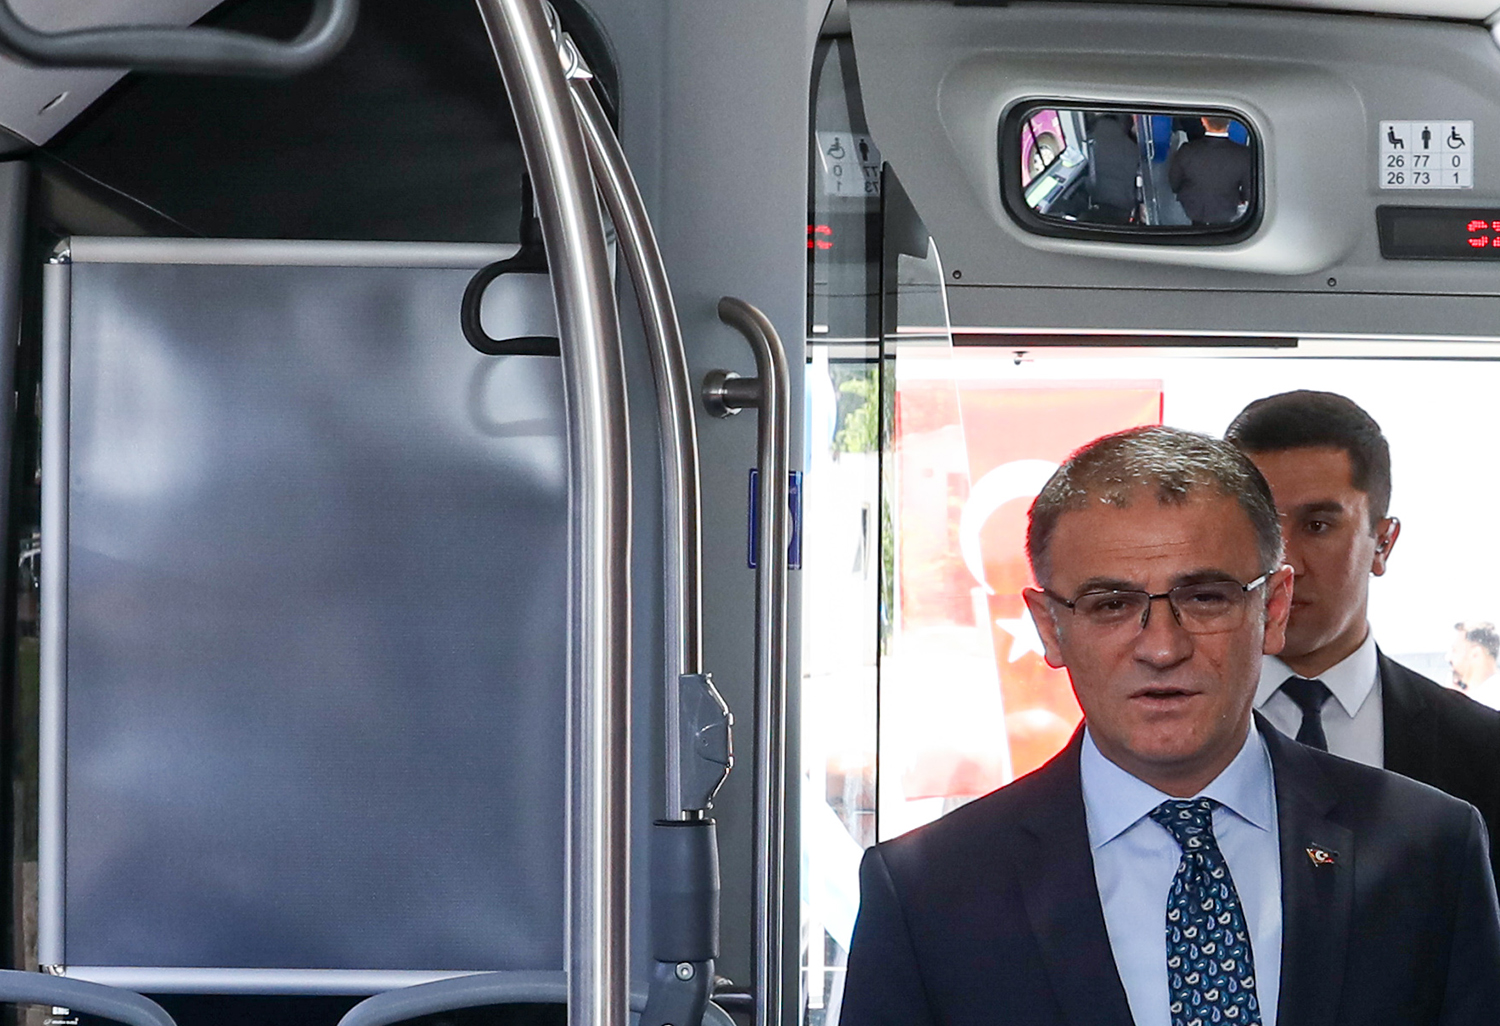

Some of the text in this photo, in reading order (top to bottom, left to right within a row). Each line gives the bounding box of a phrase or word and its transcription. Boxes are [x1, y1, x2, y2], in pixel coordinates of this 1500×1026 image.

[1387, 155, 1461, 168] 26 77 0
[1387, 172, 1459, 185] 26 73 1
